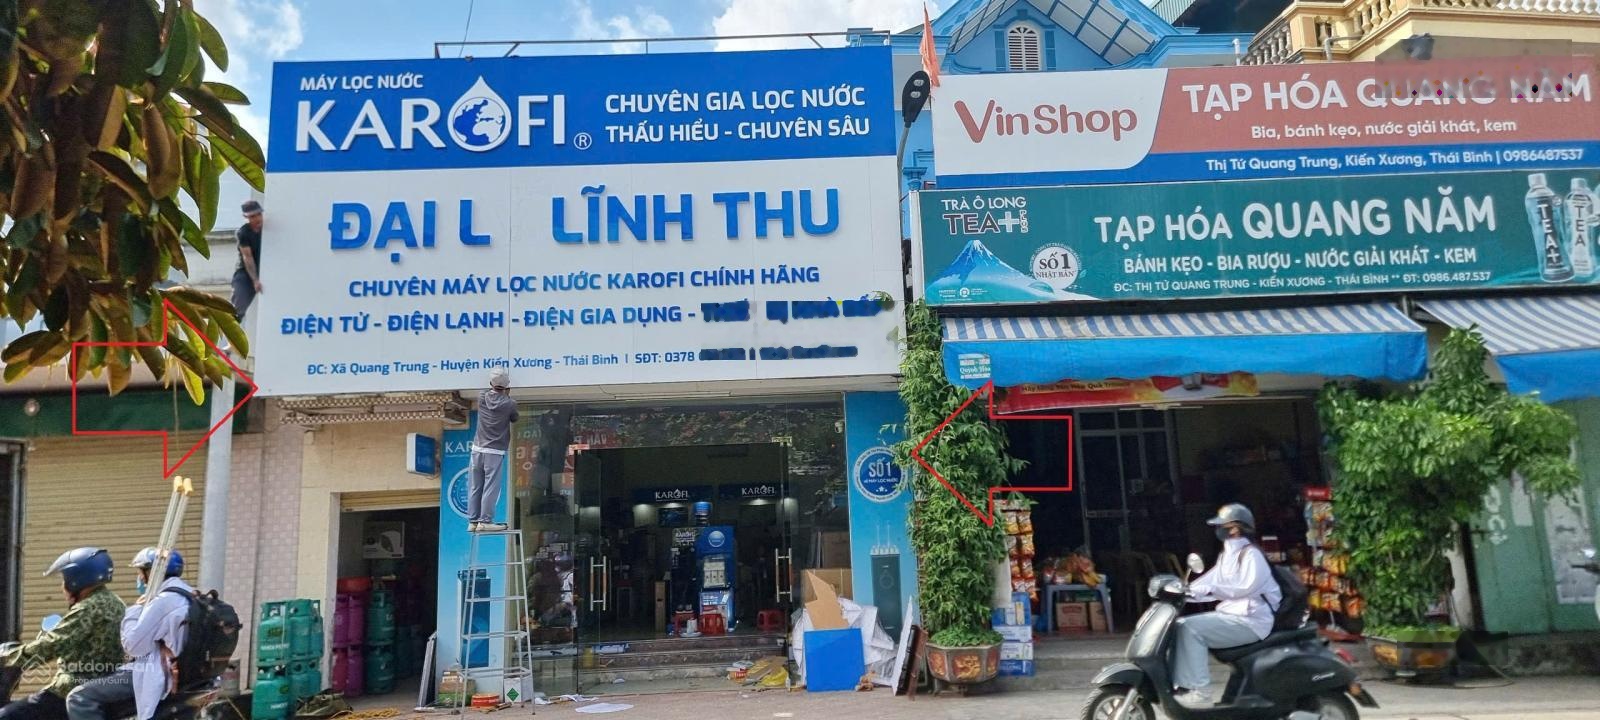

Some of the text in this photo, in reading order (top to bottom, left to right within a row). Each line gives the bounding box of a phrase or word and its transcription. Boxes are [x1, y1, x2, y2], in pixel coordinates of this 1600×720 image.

[300, 72, 424, 93] MÁY LỌC NƯỚC
[605, 83, 865, 114] CHUYÊN GIA LỌC NƯỚC
[1182, 83, 1253, 121] TẠP
[1264, 73, 1348, 111] HÓA
[296, 75, 565, 152] KAROFI
[605, 115, 870, 144] THẤU HIỂU CHUYÊN SÂU
[1251, 119, 1517, 140] Bia, bánh kẹo, nước giải khát, kem
[1206, 149, 1584, 173] Thị Tứ Quang Trung, Kiến Xương, Thái Bình 0986487537
[941, 194, 1027, 211] TRÀ Ô LONG
[328, 201, 436, 263] ĐẠI
[552, 184, 694, 244] LĨNH
[712, 187, 839, 240] THU
[1094, 185, 1496, 250] TẠP HÓA QUANG NĂM
[1039, 251, 1059, 270] SỐ
[1060, 252, 1072, 270] 1
[1124, 245, 1477, 276] BÁNH KẸO BIA RƯỢU NƯỚC GIẢI KHÁT KEM
[349, 264, 820, 298] CHUYÊN MÁY LỌC NƯỚC KAROFI CHÍNH HÃNG
[1114, 282, 1133, 292] ĐC:
[1135, 282, 1153, 293] THỊ
[1172, 280, 1210, 291] QUANG
[1213, 279, 1250, 289] TRUNG
[1259, 276, 1284, 287] KIẾN
[1287, 274, 1325, 287] XƯƠNG
[1335, 273, 1361, 286] THÁI
[1363, 272, 1388, 284] BÌNH
[281, 314, 333, 338] ĐIỆN
[339, 312, 370, 333] TỬ
[387, 311, 439, 335] ĐIỆN
[445, 311, 504, 333] LẠNH
[524, 307, 574, 331] ĐIỆN
[580, 307, 616, 325] GIA
[622, 306, 681, 327] DỤNG
[307, 363, 328, 375] ĐC:
[331, 362, 347, 374] Xã
[350, 363, 390, 376] Quang
[393, 362, 430, 375] Trung
[440, 359, 480, 373] Huyện
[513, 357, 552, 370] Xương
[563, 354, 588, 366] Thái
[592, 353, 618, 365] Bình
[635, 353, 662, 364] SĐT:
[665, 351, 695, 363] 0378
[868, 457, 892, 478] SỐ 1
[655, 489, 689, 500] KAROFI
[741, 485, 775, 496] KAROFI
